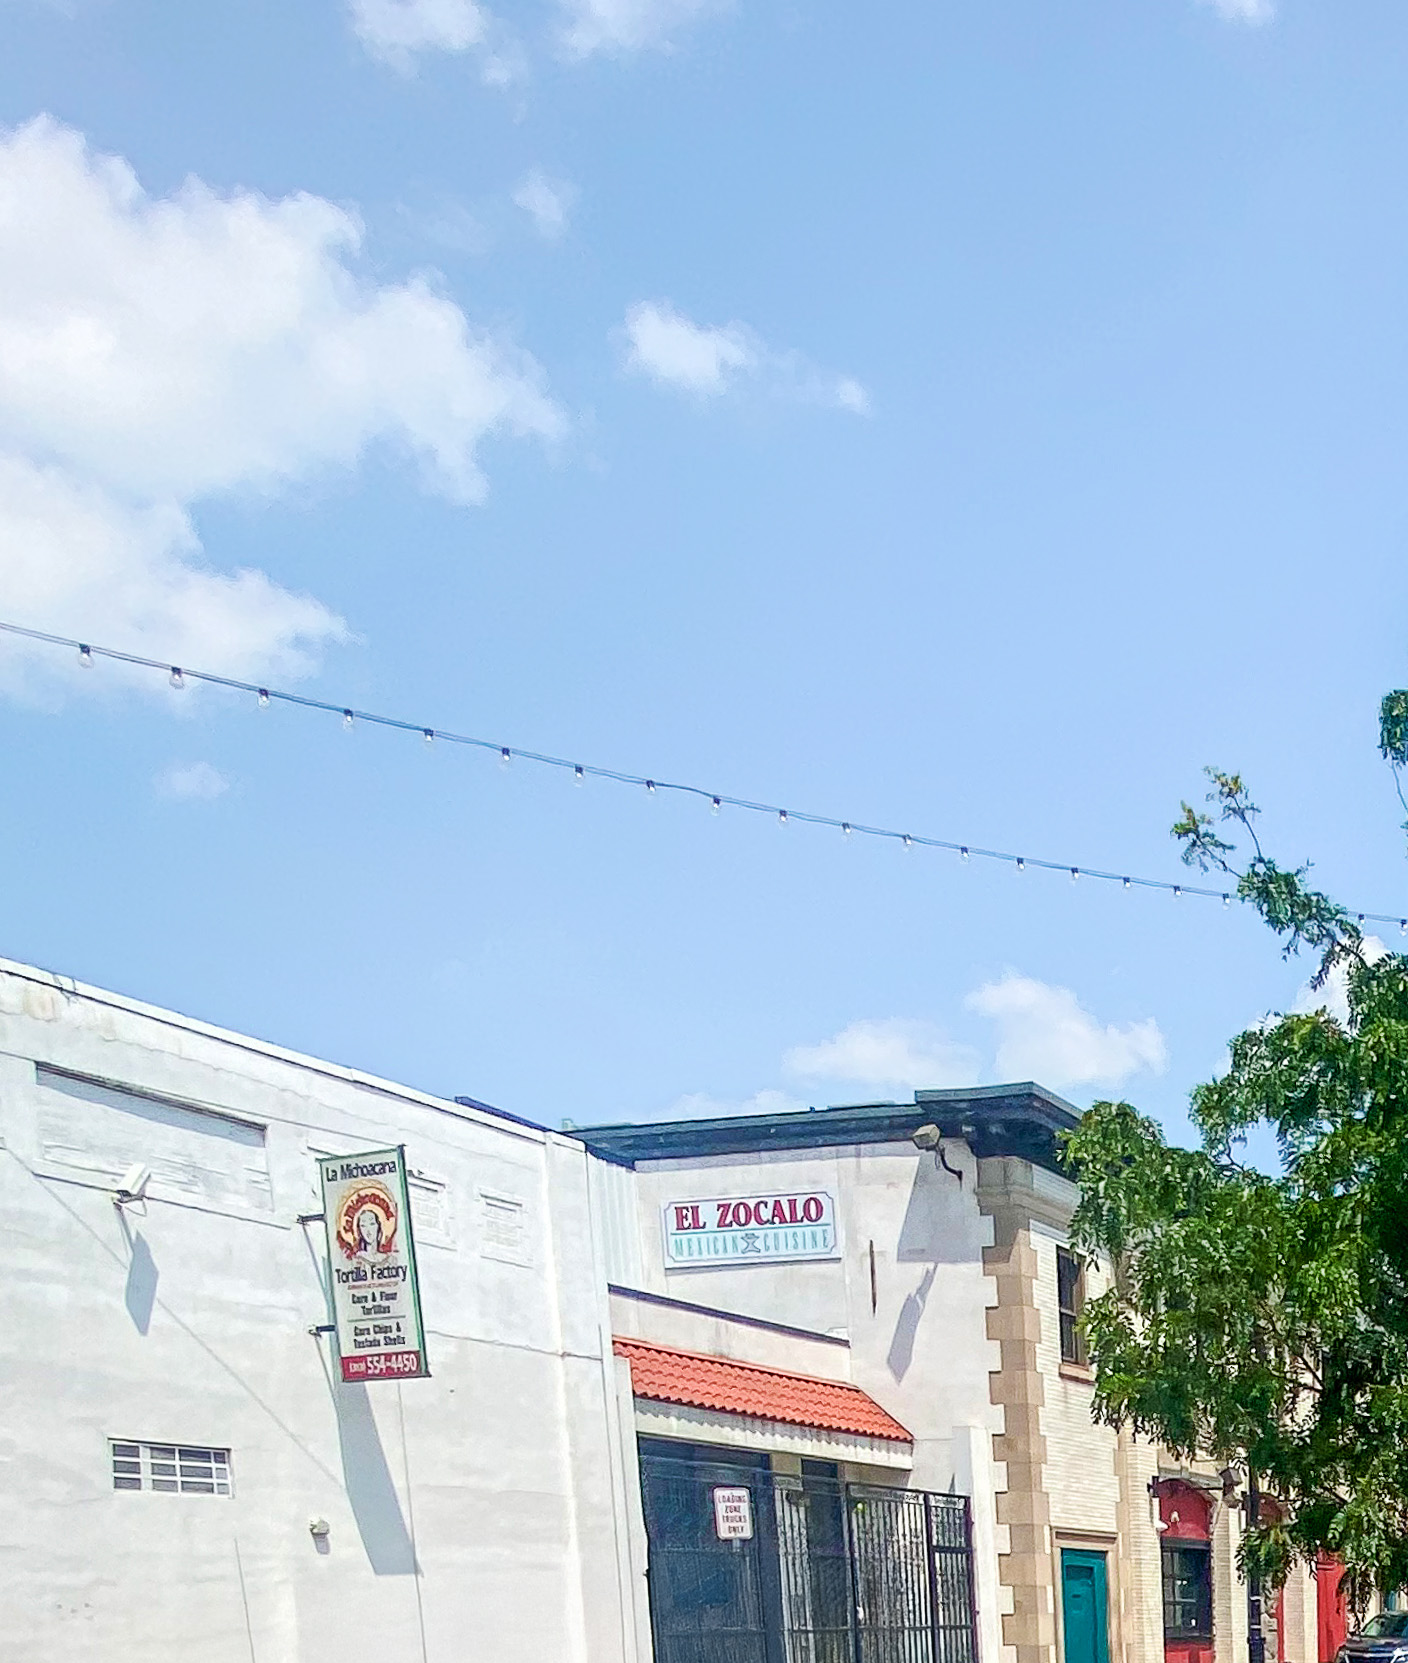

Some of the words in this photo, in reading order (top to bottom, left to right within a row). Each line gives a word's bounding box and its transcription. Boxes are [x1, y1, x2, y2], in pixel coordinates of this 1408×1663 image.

[326, 1167, 338, 1182] La
[675, 1204, 707, 1231] EL
[717, 1196, 824, 1228] ZOCALO
[674, 1235, 739, 1257] MEXICAN
[763, 1229, 830, 1253] CUISINE
[335, 1267, 368, 1283] Tortilla
[371, 1265, 408, 1282] Factory
